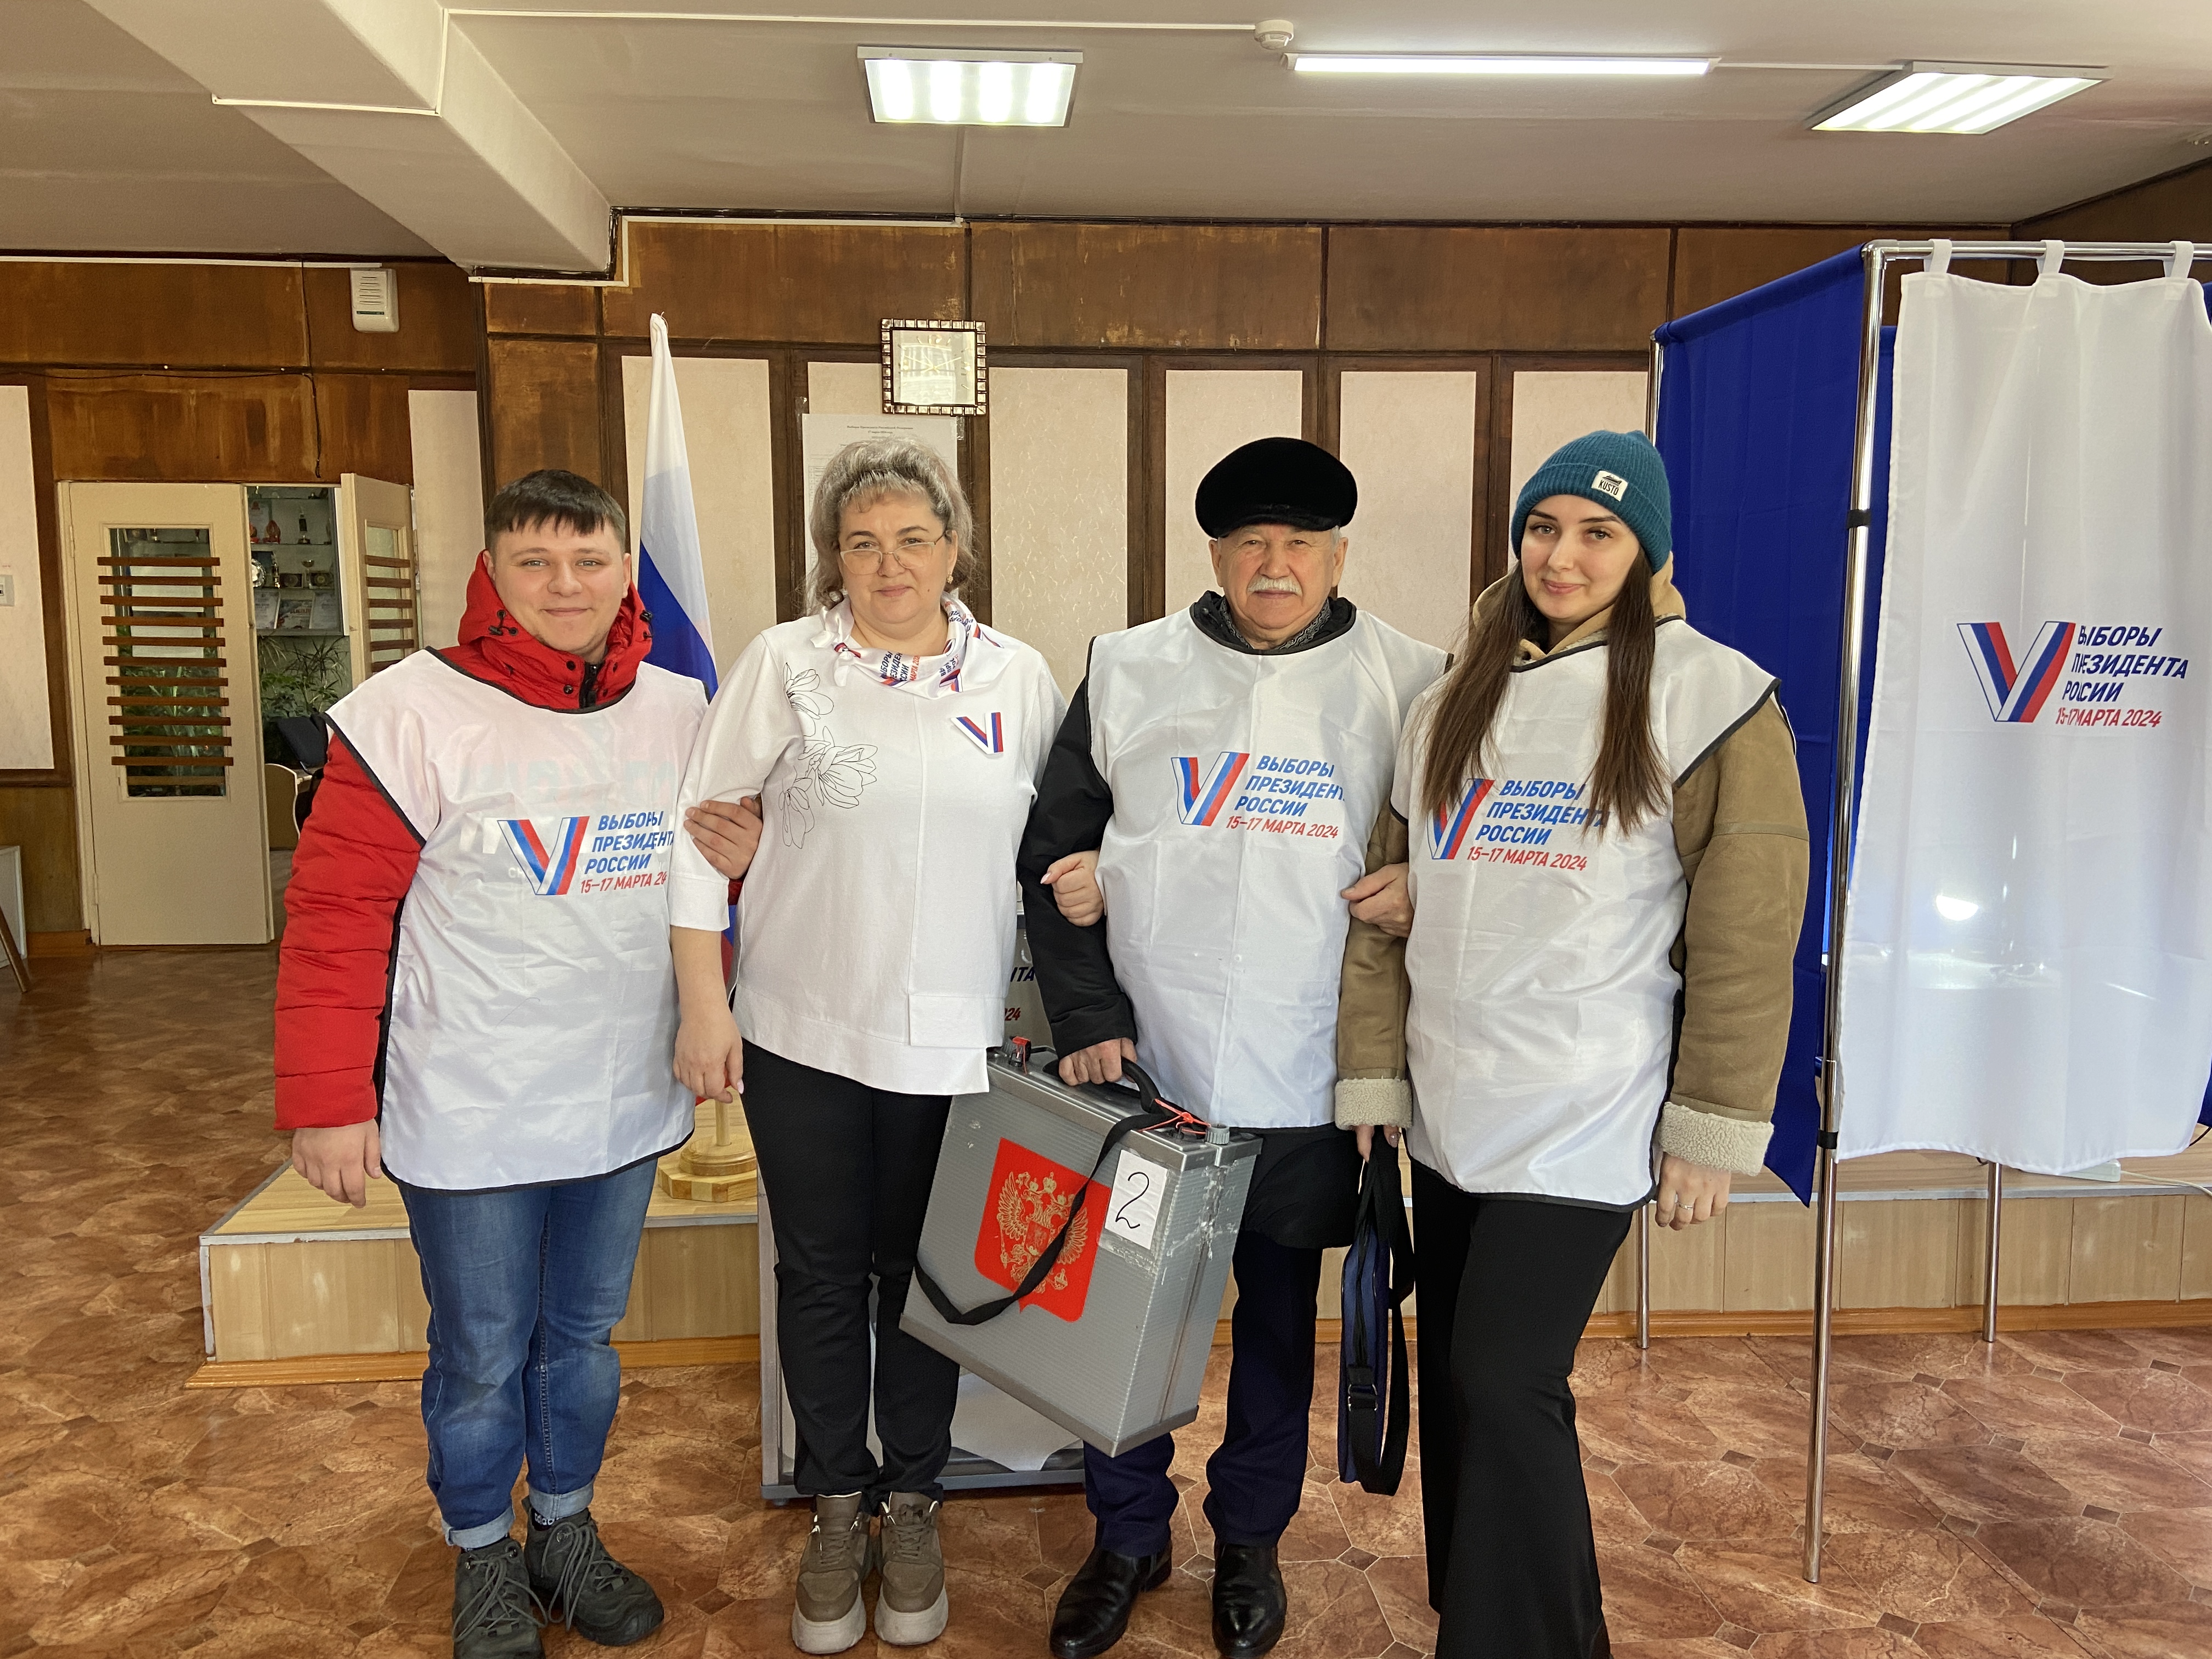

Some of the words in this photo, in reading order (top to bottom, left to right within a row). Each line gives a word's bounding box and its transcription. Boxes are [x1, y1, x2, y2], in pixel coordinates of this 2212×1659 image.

[1598, 480, 1619, 495] KUSTO
[2075, 709, 2121, 726] МАРТА
[2121, 710, 2162, 727] 2024
[1256, 755, 1335, 778] ВЫБОРЫ
[1244, 775, 1345, 802] ПРЕЗИДЕНТ
[1499, 780, 1585, 800] ВЫБОРЫ
[1234, 796, 1308, 817] РОССИИ
[598, 811, 664, 831] ВЫБОРЫ
[1261, 819, 1306, 836] МАРТА
[1306, 825, 1339, 839] 2024
[1475, 824, 1552, 845] РОССИИ
[584, 854, 652, 874] РОССИИ
[1502, 850, 1550, 867] МАРТА
[1550, 853, 1588, 871] 2024
[614, 873, 651, 890] МАРТА
[1115, 1172, 1149, 1229] 2
